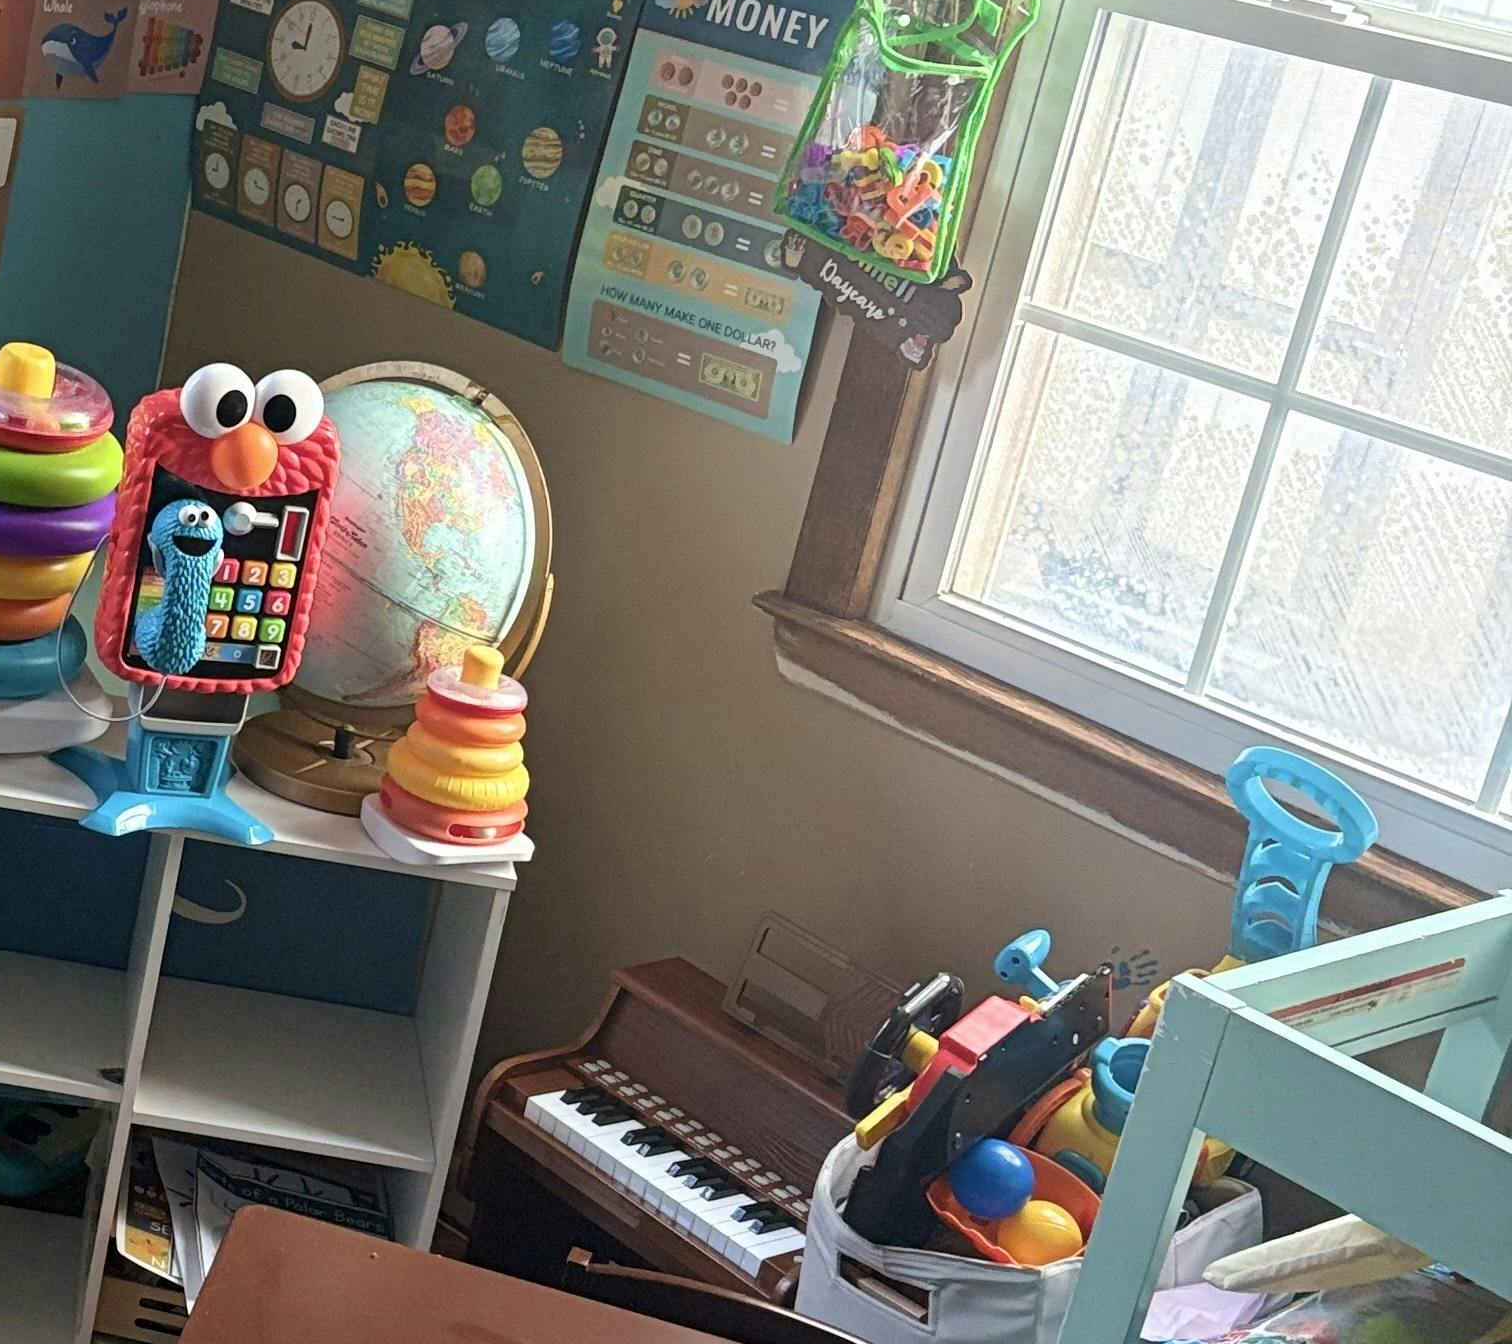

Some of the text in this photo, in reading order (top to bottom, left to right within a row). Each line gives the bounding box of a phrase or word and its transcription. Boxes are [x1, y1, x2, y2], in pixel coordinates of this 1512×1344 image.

[601, 285, 777, 351] HOW MANY MAKE ONE DOLLAR?
[223, 565, 289, 584] 1 2 3
[215, 592, 284, 612] 4 5 6
[211, 620, 280, 639] 7 8 9
